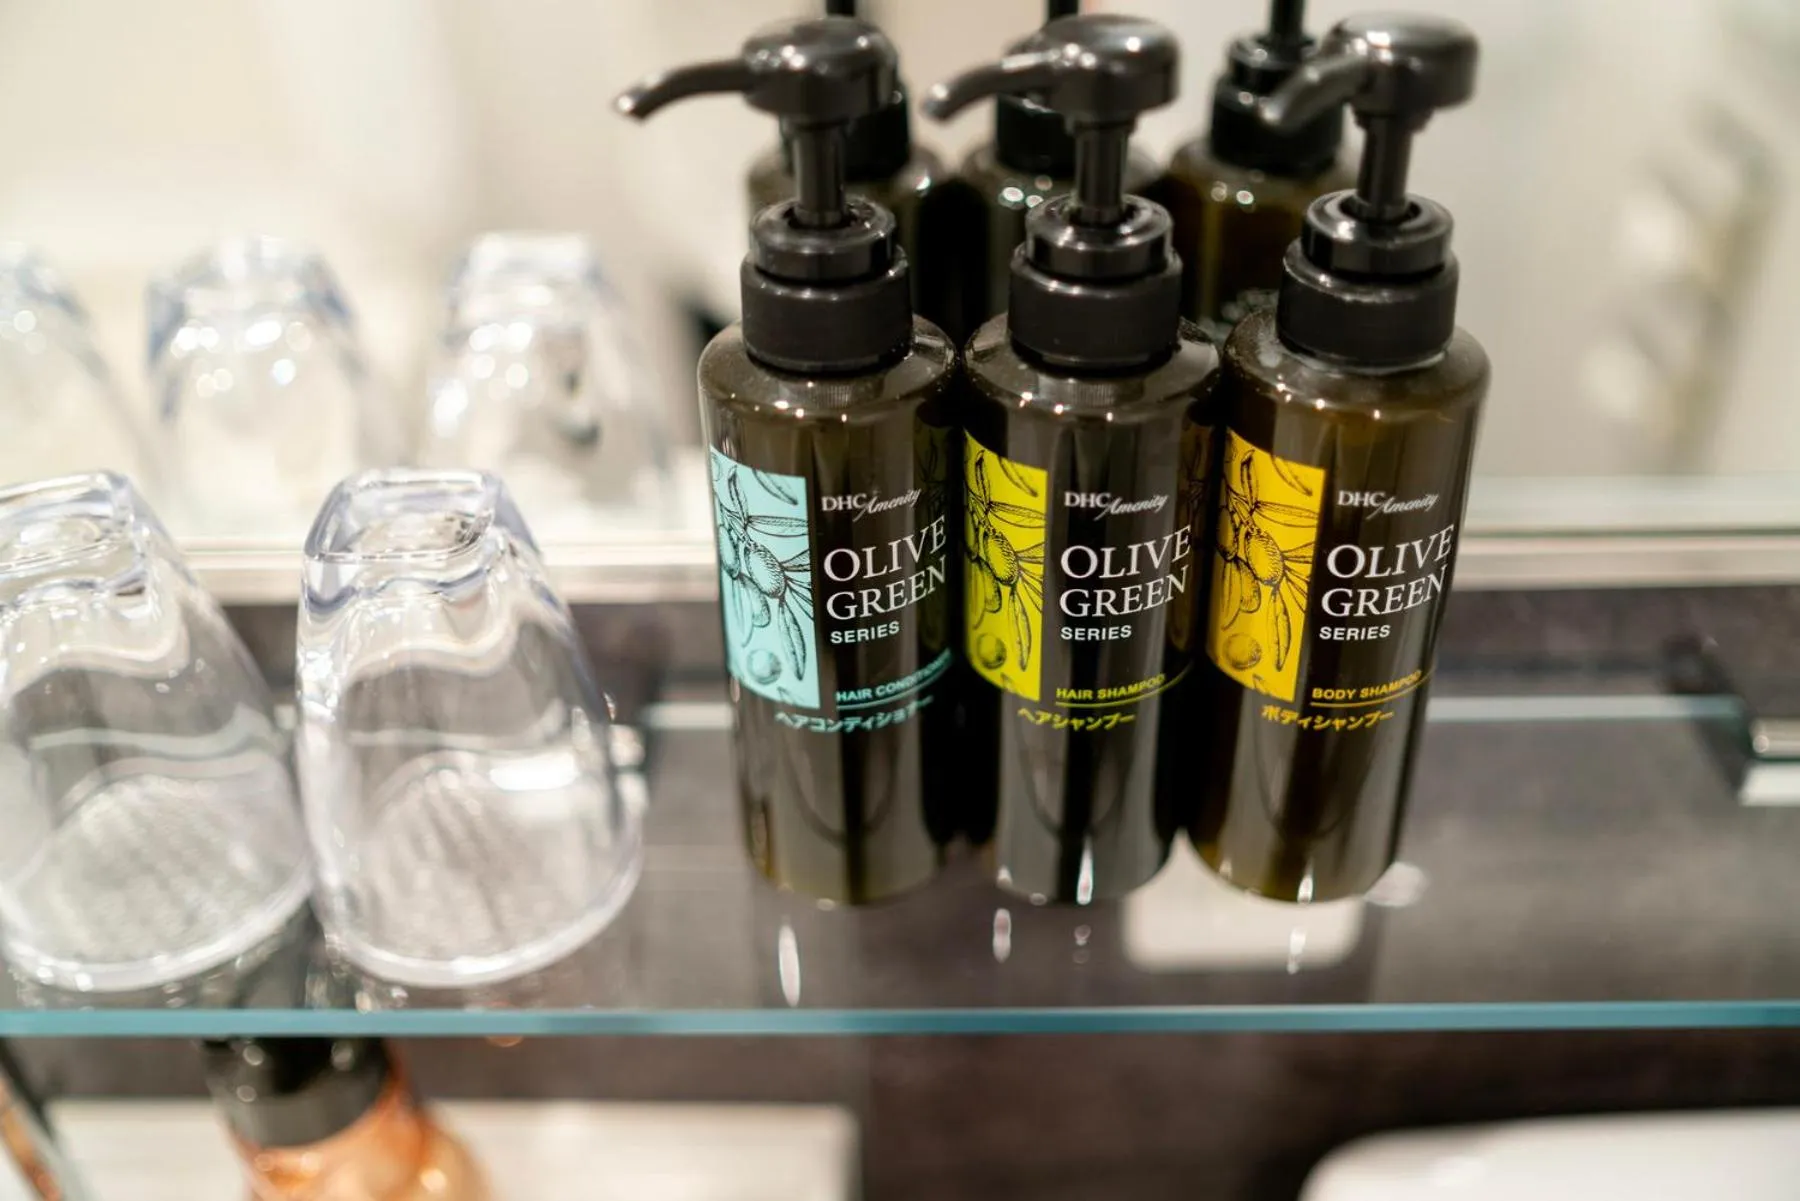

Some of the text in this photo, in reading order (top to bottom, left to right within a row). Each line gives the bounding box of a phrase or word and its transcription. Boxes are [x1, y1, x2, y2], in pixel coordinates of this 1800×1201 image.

[822, 488, 921, 522] DHC Amenity
[1064, 492, 1169, 521] DHC Amenity
[1338, 490, 1440, 520] DHC Amenity
[824, 515, 947, 581] OLIVE
[1061, 524, 1191, 579] OLIVE
[1327, 523, 1455, 579] OLIVE
[826, 557, 946, 620] GREEN
[1060, 565, 1187, 617] GREEN
[1322, 562, 1448, 618] GREEN
[830, 621, 900, 644] SERIES
[1061, 625, 1132, 641] SERIES
[1319, 624, 1391, 641] SERIES
[836, 688, 872, 701] HAIR
[1056, 673, 1165, 700] HAIR SHAMPOO
[1312, 687, 1356, 700] BODY
